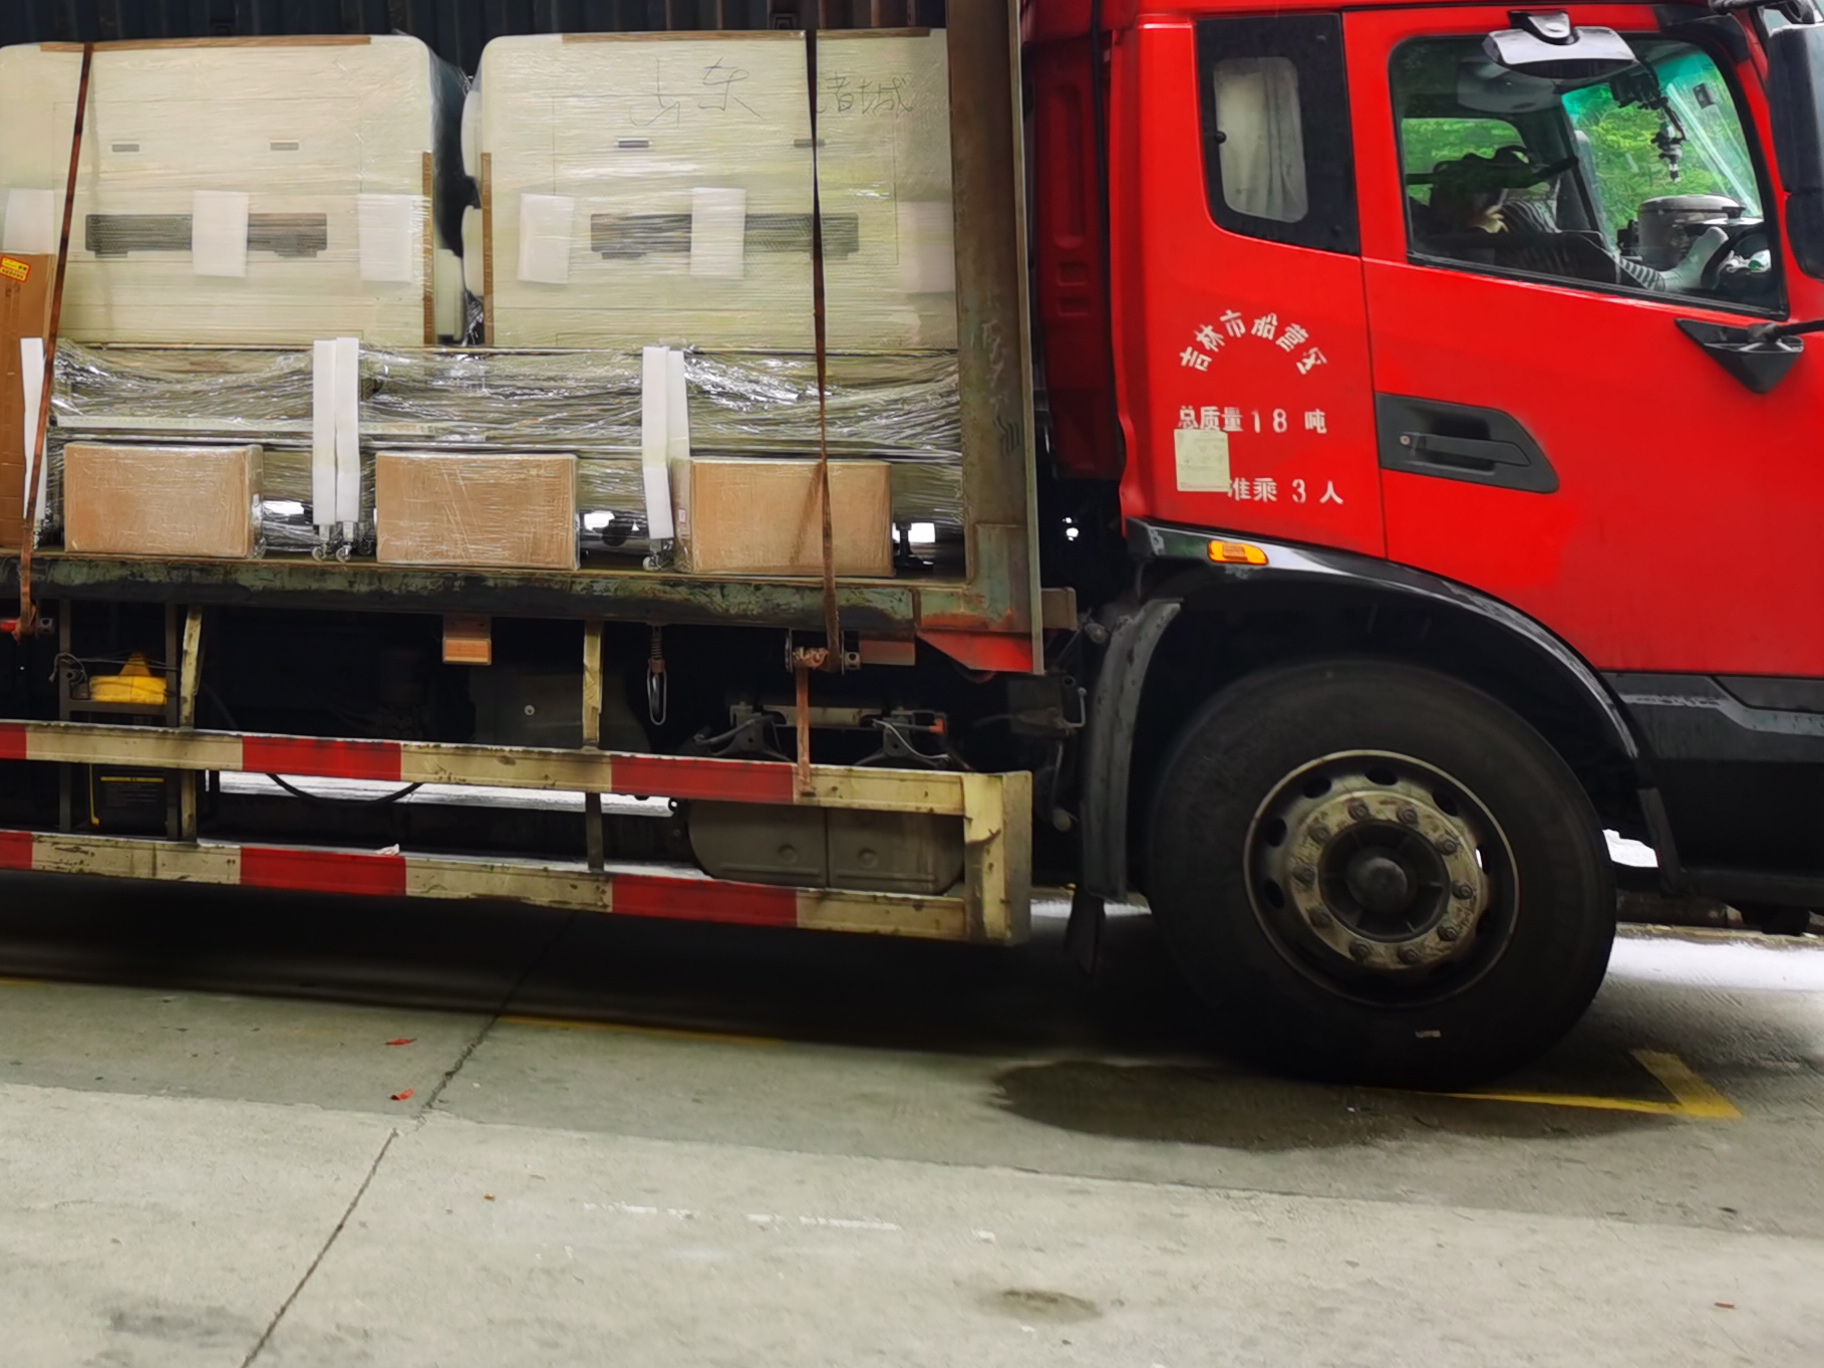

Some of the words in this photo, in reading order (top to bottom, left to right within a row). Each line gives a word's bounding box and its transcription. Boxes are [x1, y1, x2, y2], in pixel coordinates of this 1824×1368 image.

[1179, 309, 1328, 375] 吉林市船营区
